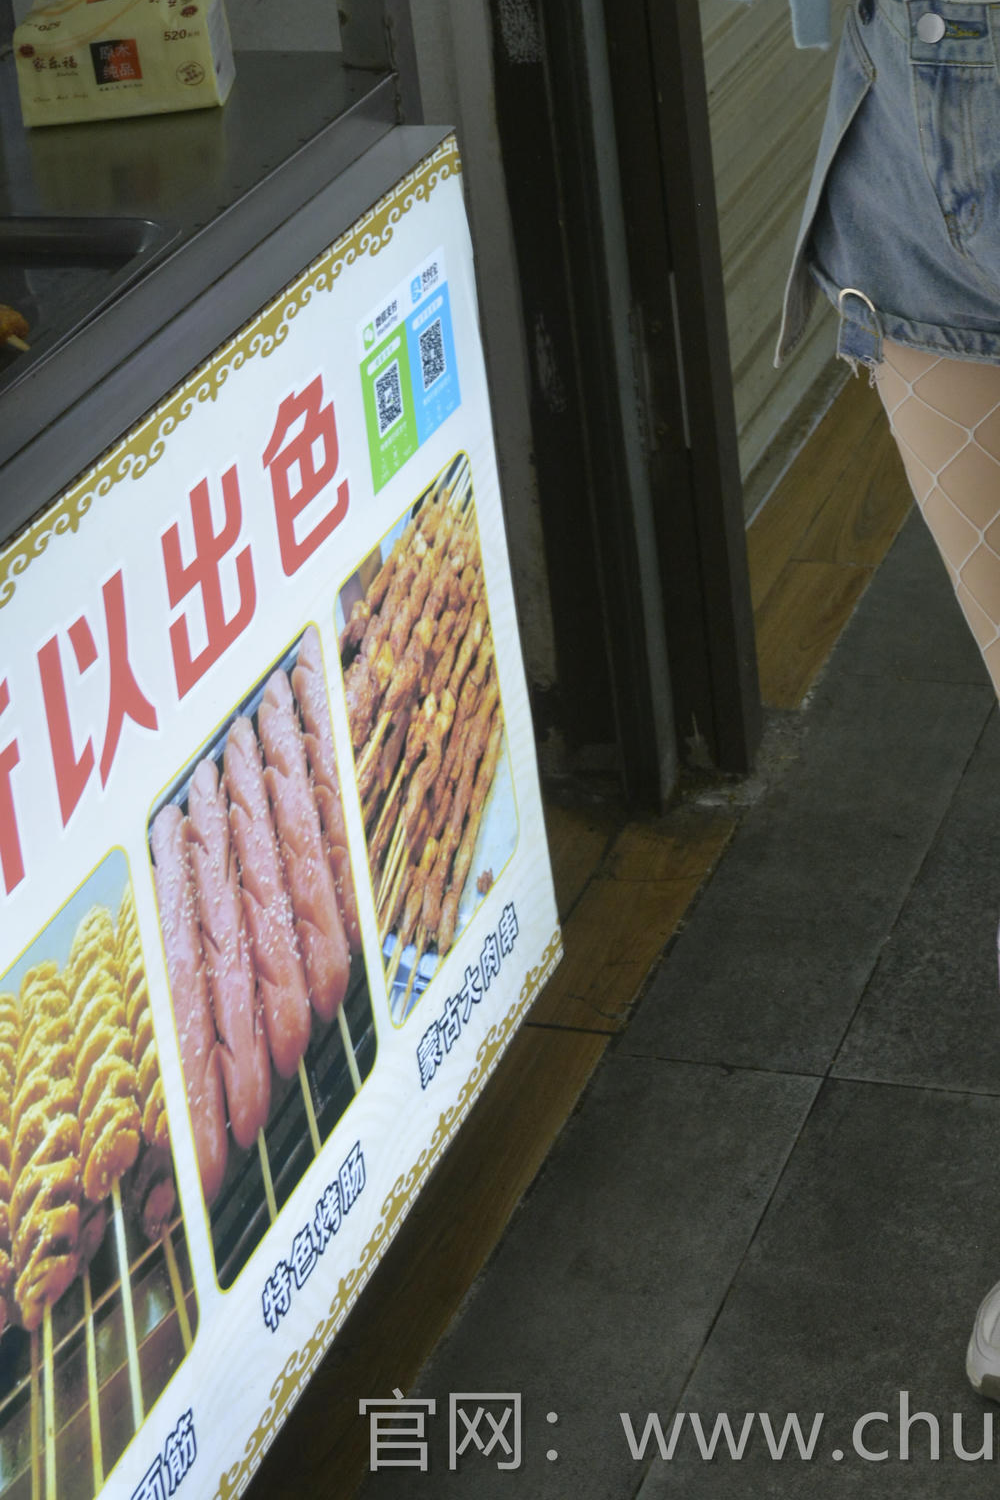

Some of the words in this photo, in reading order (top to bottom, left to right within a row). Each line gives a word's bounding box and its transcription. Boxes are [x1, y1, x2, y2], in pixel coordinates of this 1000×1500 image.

[0, 372, 350, 897] 以出色
[416, 901, 520, 1090] 蒙古大肉串
[261, 1139, 367, 1333] 特色烤肠
